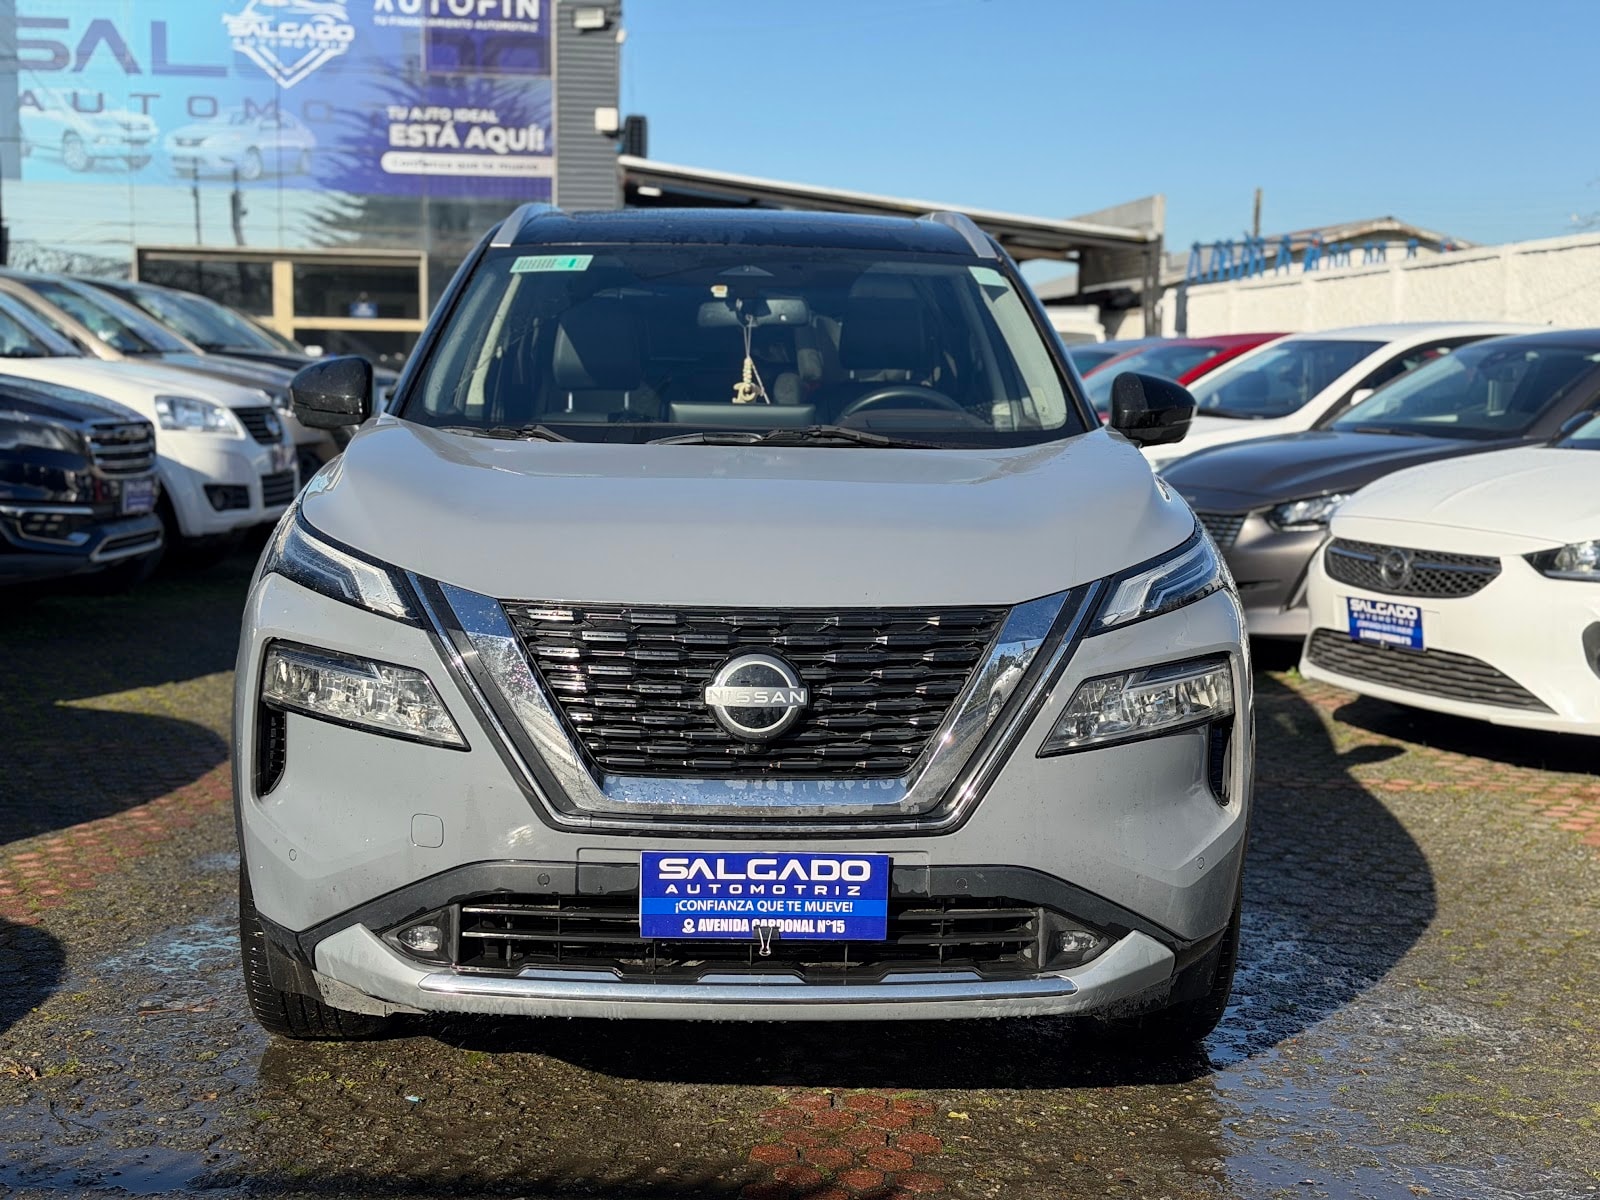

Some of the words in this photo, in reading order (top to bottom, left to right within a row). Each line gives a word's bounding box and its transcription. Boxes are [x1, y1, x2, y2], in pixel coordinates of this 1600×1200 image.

[227, 21, 355, 42] SALGADO
[387, 105, 408, 120] TU
[454, 108, 499, 123] IDEAL
[389, 120, 461, 148] ESTÁ
[1349, 598, 1418, 620] SALGADO
[707, 689, 805, 704] NISSAN
[658, 858, 871, 881] SALGADO
[665, 883, 861, 896] AUTOMOTRIZ
[675, 899, 754, 913] ¡CONFIANZA
[757, 900, 784, 912] QUE
[786, 900, 801, 912] TE
[804, 901, 853, 913] MUEVE!
[698, 918, 750, 933] AVENIDA
